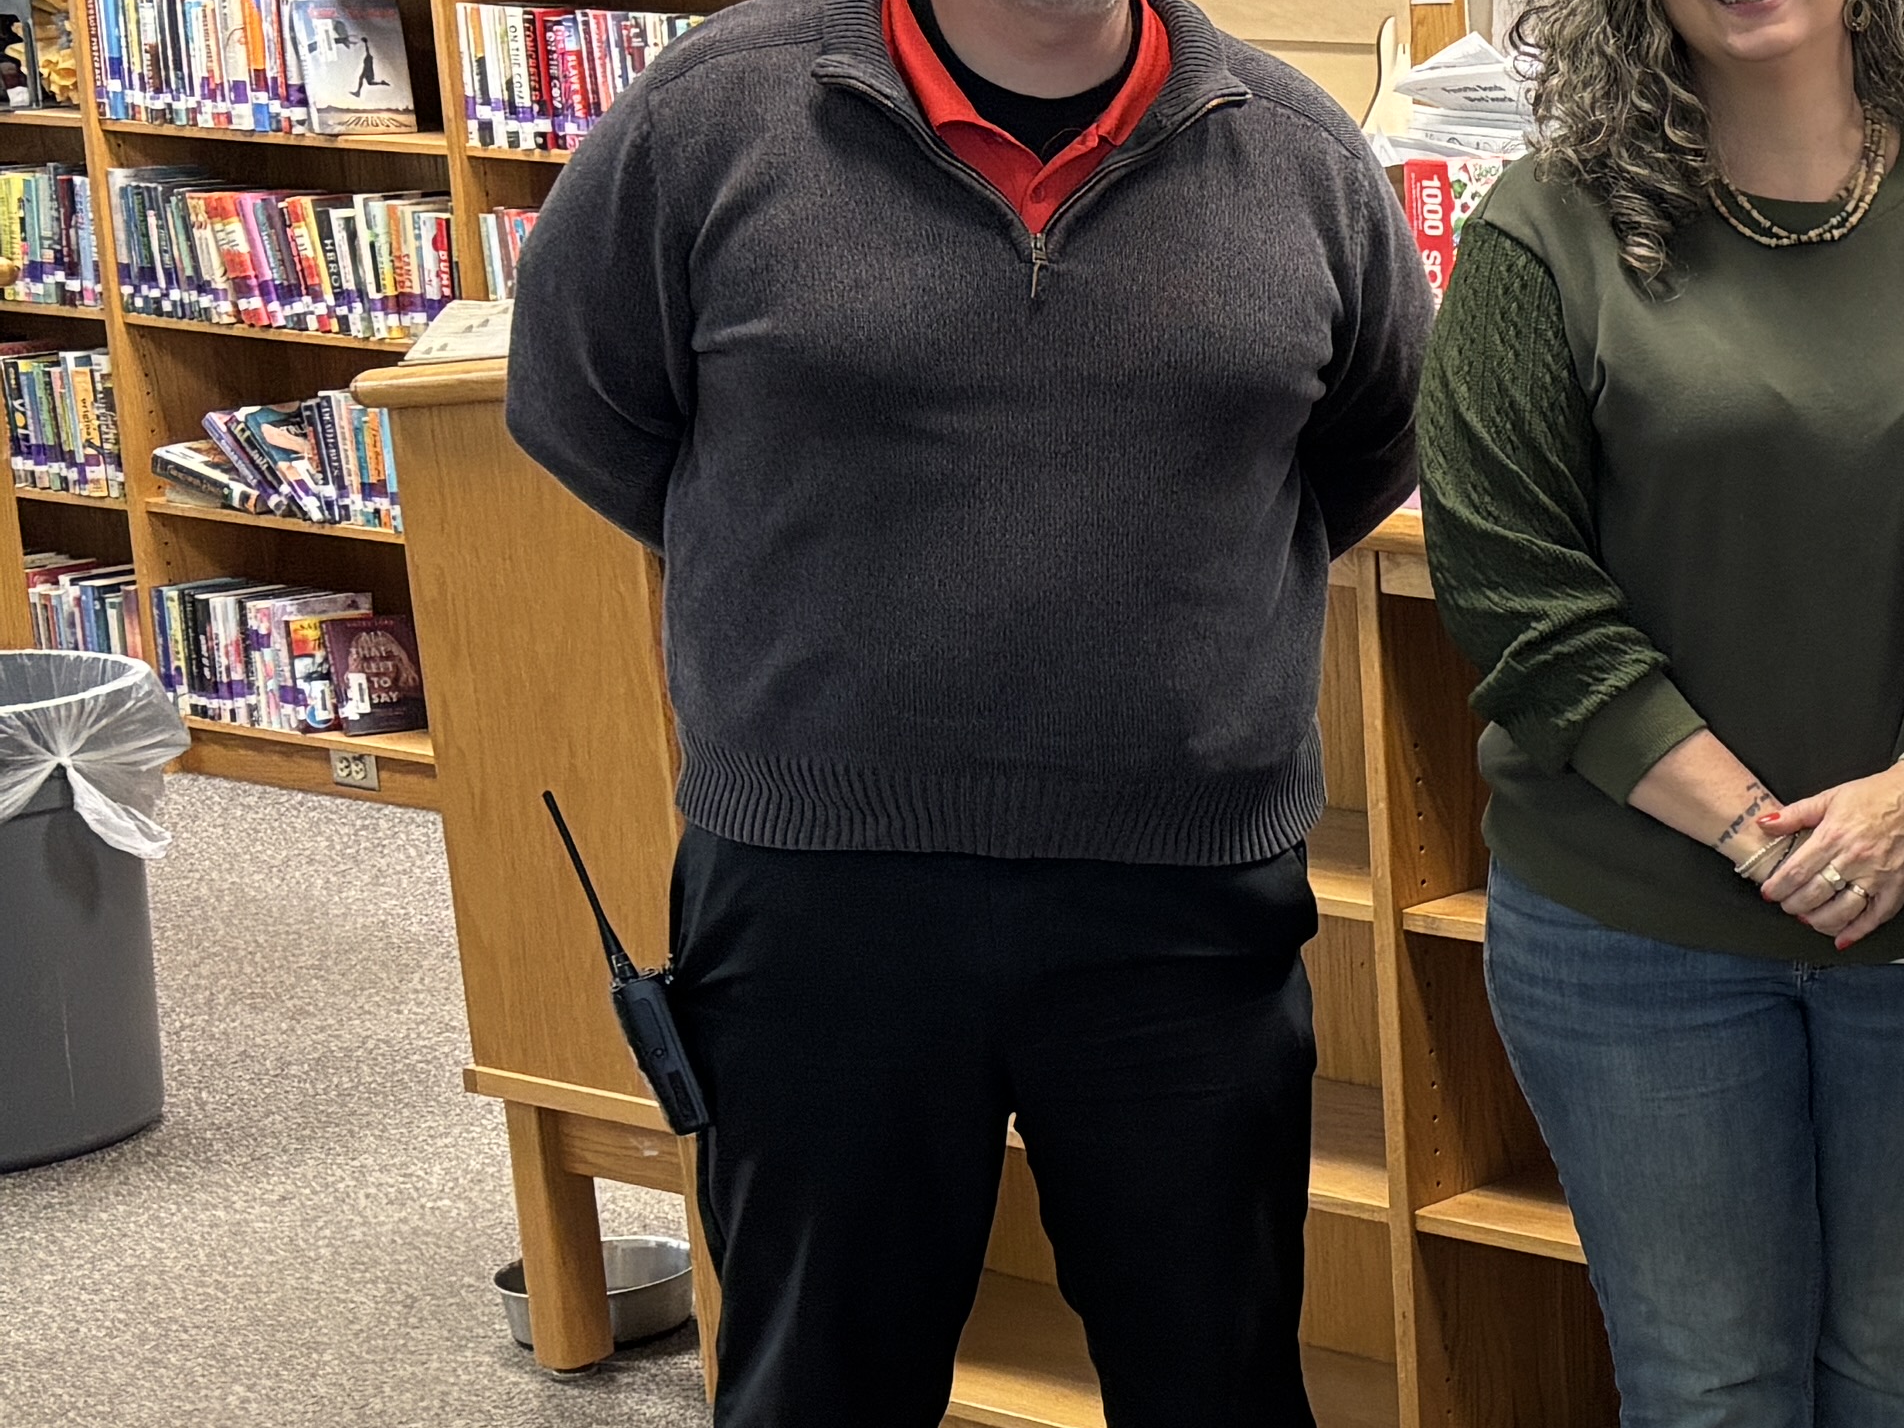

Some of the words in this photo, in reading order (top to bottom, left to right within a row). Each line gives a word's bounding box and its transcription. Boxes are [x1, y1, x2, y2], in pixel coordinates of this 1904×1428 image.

[1420, 174, 1444, 236] 1000
[370, 676, 392, 689] TO
[371, 691, 399, 704] SAY
